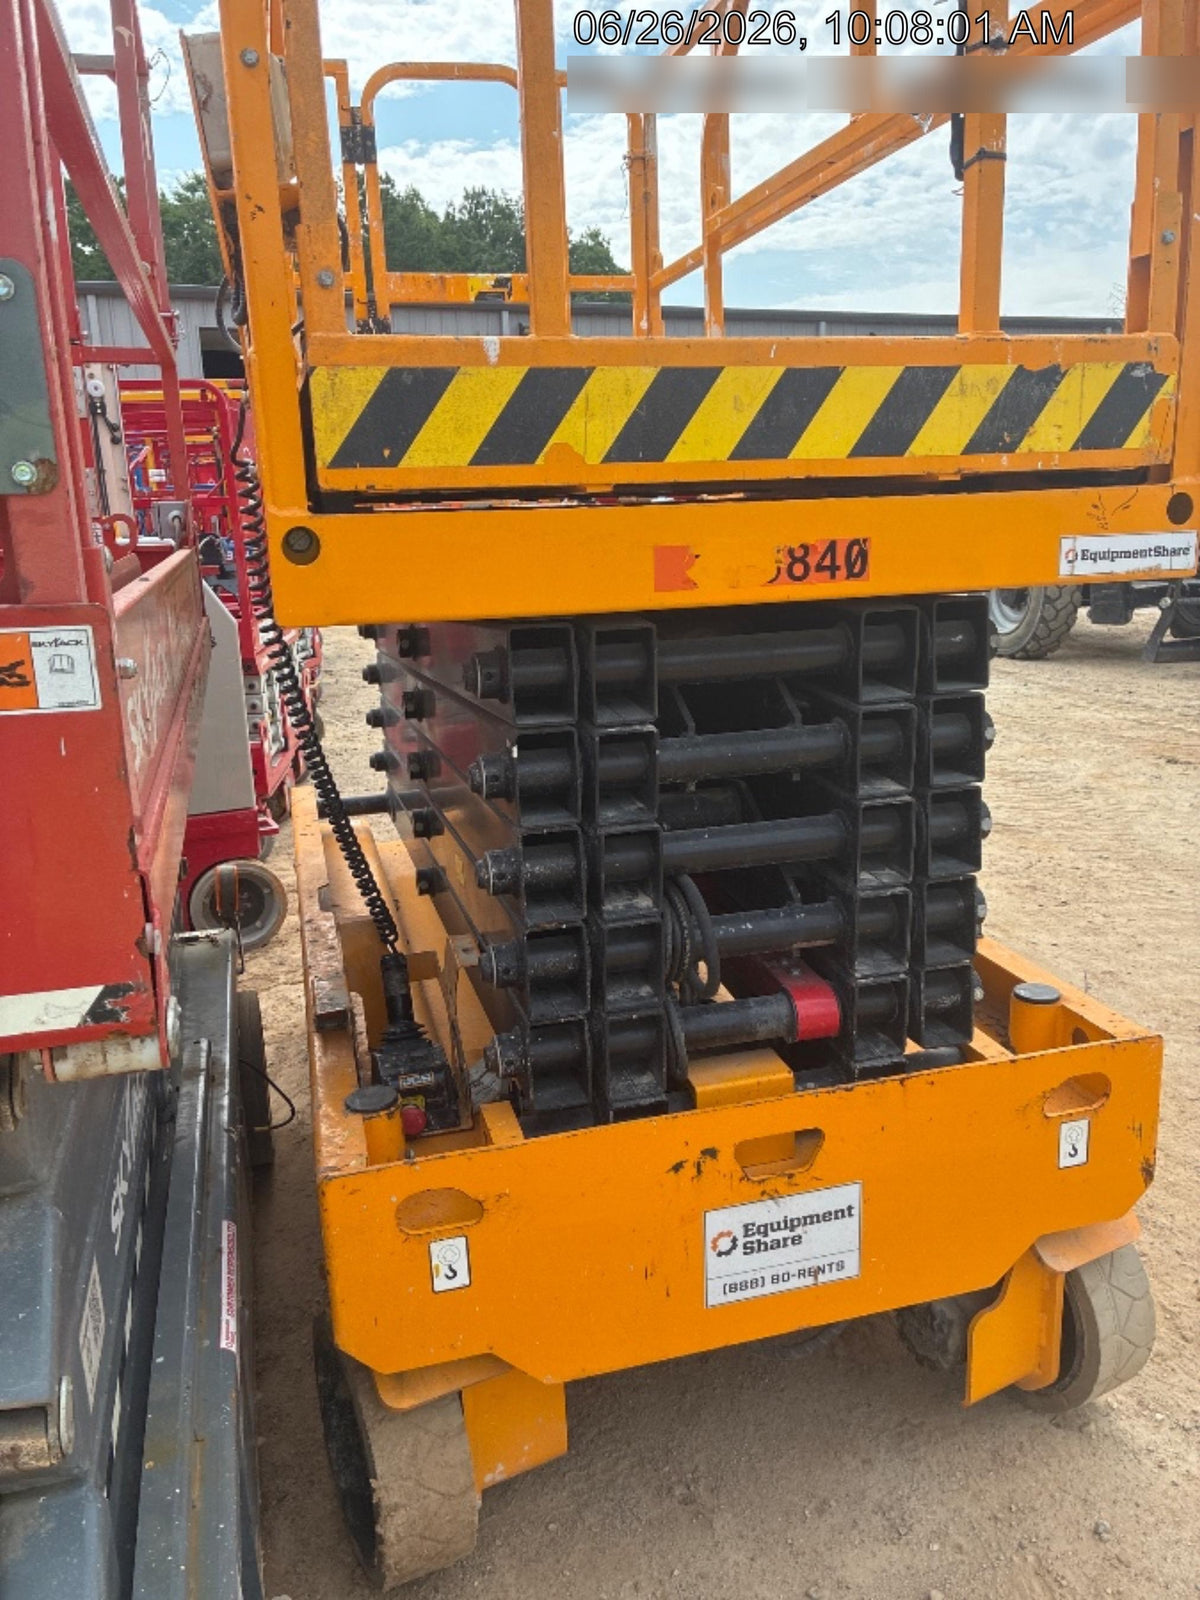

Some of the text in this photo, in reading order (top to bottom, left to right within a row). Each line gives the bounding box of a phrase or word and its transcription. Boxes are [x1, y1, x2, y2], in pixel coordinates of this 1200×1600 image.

[1081, 545, 1191, 563] EquipmentShare
[742, 1204, 855, 1238] Equipment
[742, 1234, 803, 1256] Share
[722, 1277, 766, 1296] (888)
